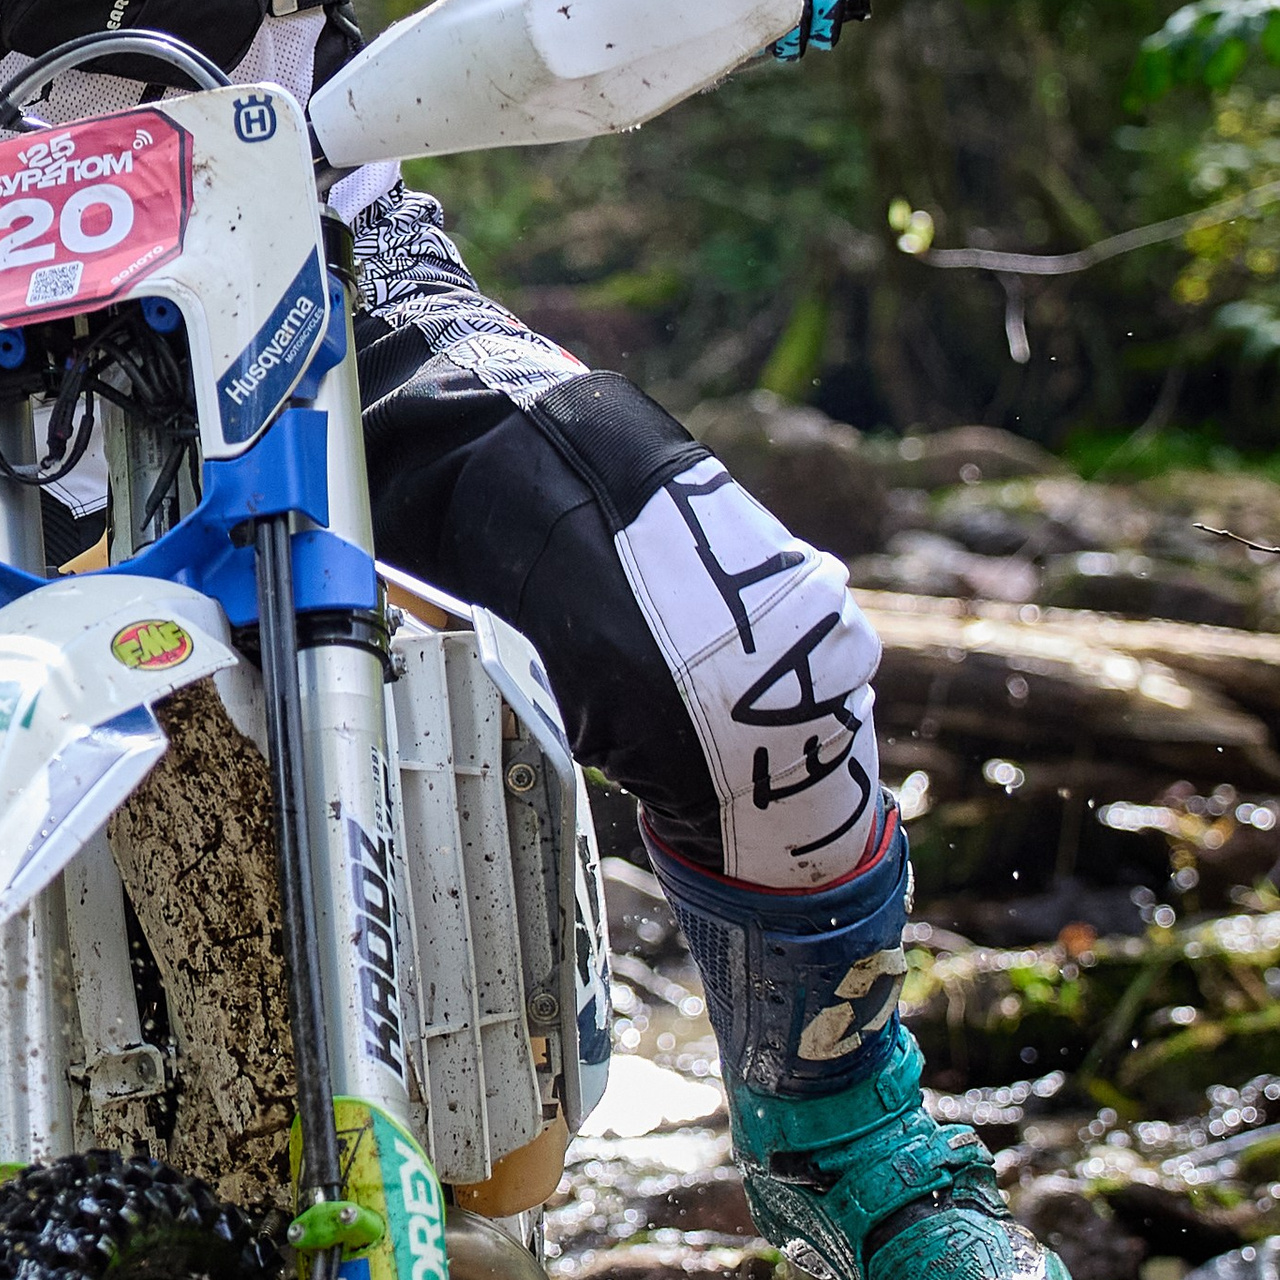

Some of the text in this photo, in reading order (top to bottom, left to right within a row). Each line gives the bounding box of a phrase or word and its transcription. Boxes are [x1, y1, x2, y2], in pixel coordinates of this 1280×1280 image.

[110, 245, 165, 285] ЗОЛОТО
[225, 295, 315, 406] Husqvarna
[284, 306, 326, 365] MOTORCYCLES
[114, 620, 185, 668] FMF
